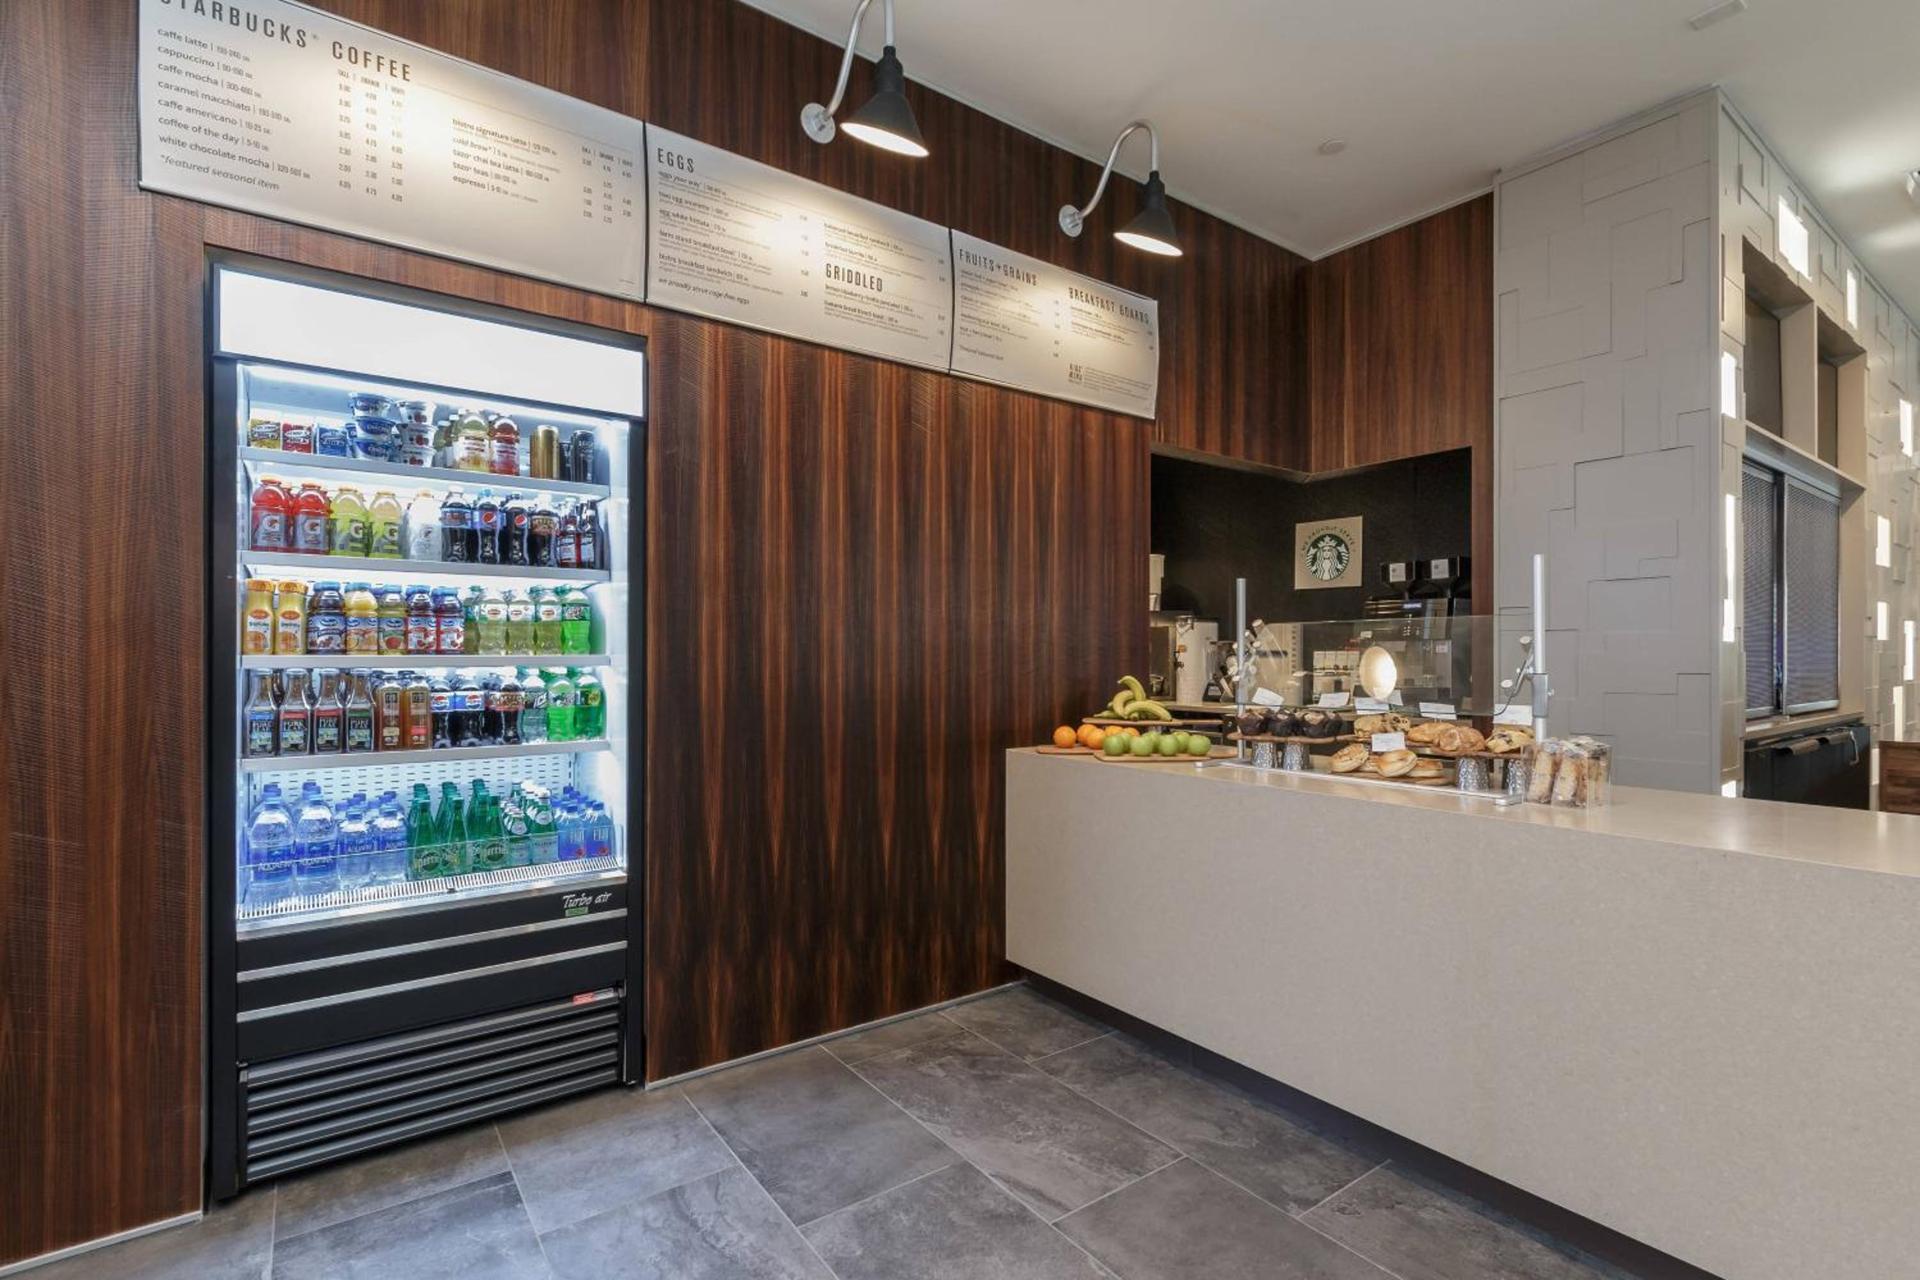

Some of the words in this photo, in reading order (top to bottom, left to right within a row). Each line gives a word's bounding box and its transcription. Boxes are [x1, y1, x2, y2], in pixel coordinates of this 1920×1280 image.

[184, 35, 208, 49] latte
[158, 45, 215, 67] cappuccino
[332, 41, 410, 82] COFFEE
[185, 71, 218, 85] mocha
[158, 80, 199, 97] caramel
[201, 92, 251, 112] macchiato
[186, 106, 238, 126] americano
[158, 116, 189, 130] coffee
[192, 124, 202, 134] of
[204, 126, 220, 138] the
[222, 132, 240, 145] day
[158, 135, 187, 148] white
[190, 142, 236, 161] chocolate
[238, 154, 270, 169] mocha
[658, 147, 695, 174] EGGS
[212, 167, 256, 186] seasonal
[258, 178, 280, 190] item
[453, 176, 486, 189] espresso
[826, 263, 882, 292] GRIDDLED
[1068, 286, 1115, 313] BREAKFAST
[562, 892, 592, 908] Turbo
[595, 891, 612, 904] air
